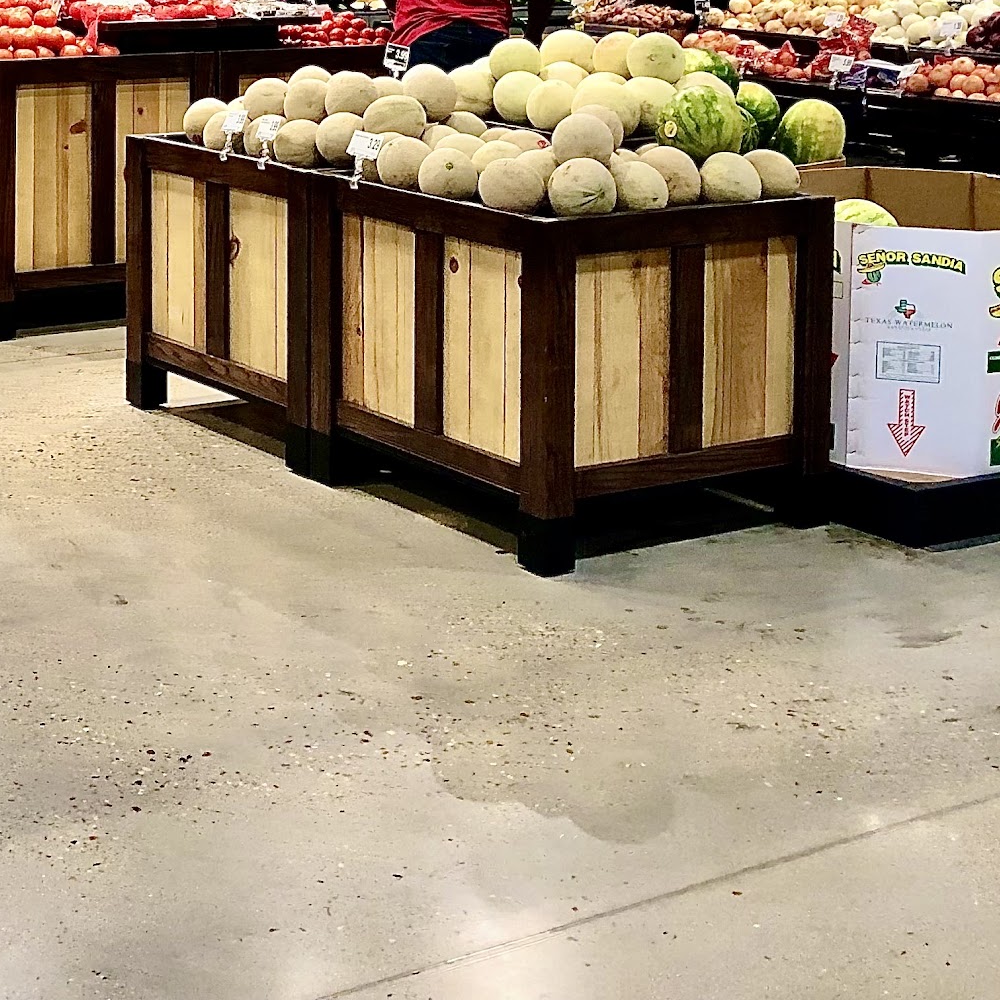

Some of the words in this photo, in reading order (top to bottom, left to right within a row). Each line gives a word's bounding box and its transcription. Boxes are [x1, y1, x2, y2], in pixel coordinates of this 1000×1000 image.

[859, 250, 908, 265] SEÑOR
[865, 316, 891, 325] TEXAS
[895, 320, 953, 329] WATERMELON
